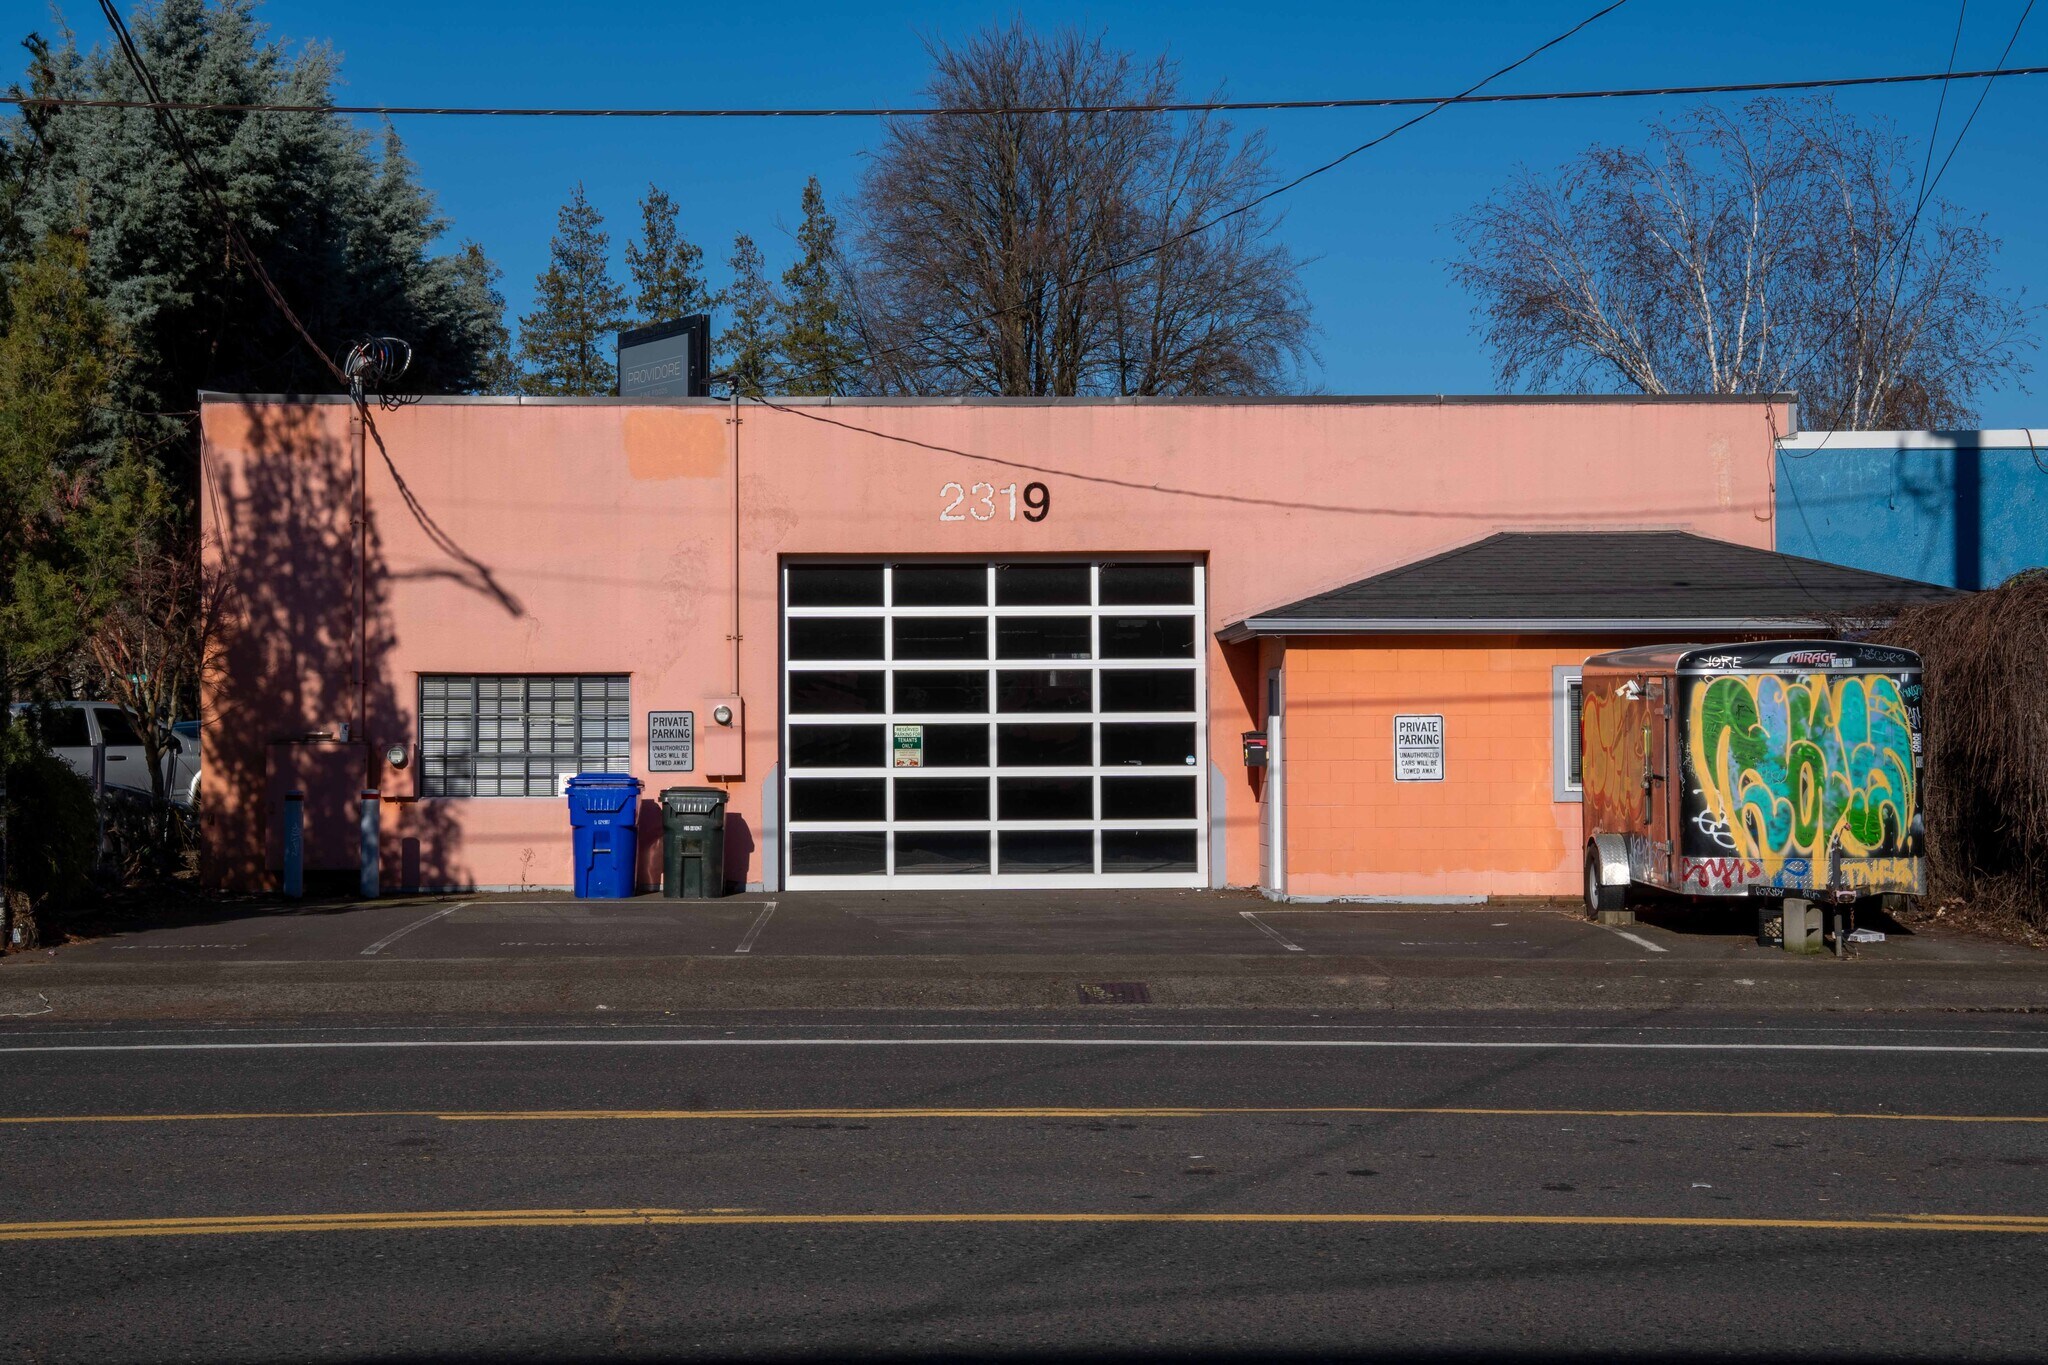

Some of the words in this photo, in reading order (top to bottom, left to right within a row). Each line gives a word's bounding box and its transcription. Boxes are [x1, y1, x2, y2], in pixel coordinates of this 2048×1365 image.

[628, 361, 681, 385] PROVIDORE
[939, 481, 1051, 523] 2319
[1790, 652, 1838, 664] MIRAGE
[652, 717, 689, 727] PRIVATE
[1399, 721, 1438, 732] PRIVATE
[652, 729, 690, 738] PARKING
[1398, 734, 1440, 745] PARKING
